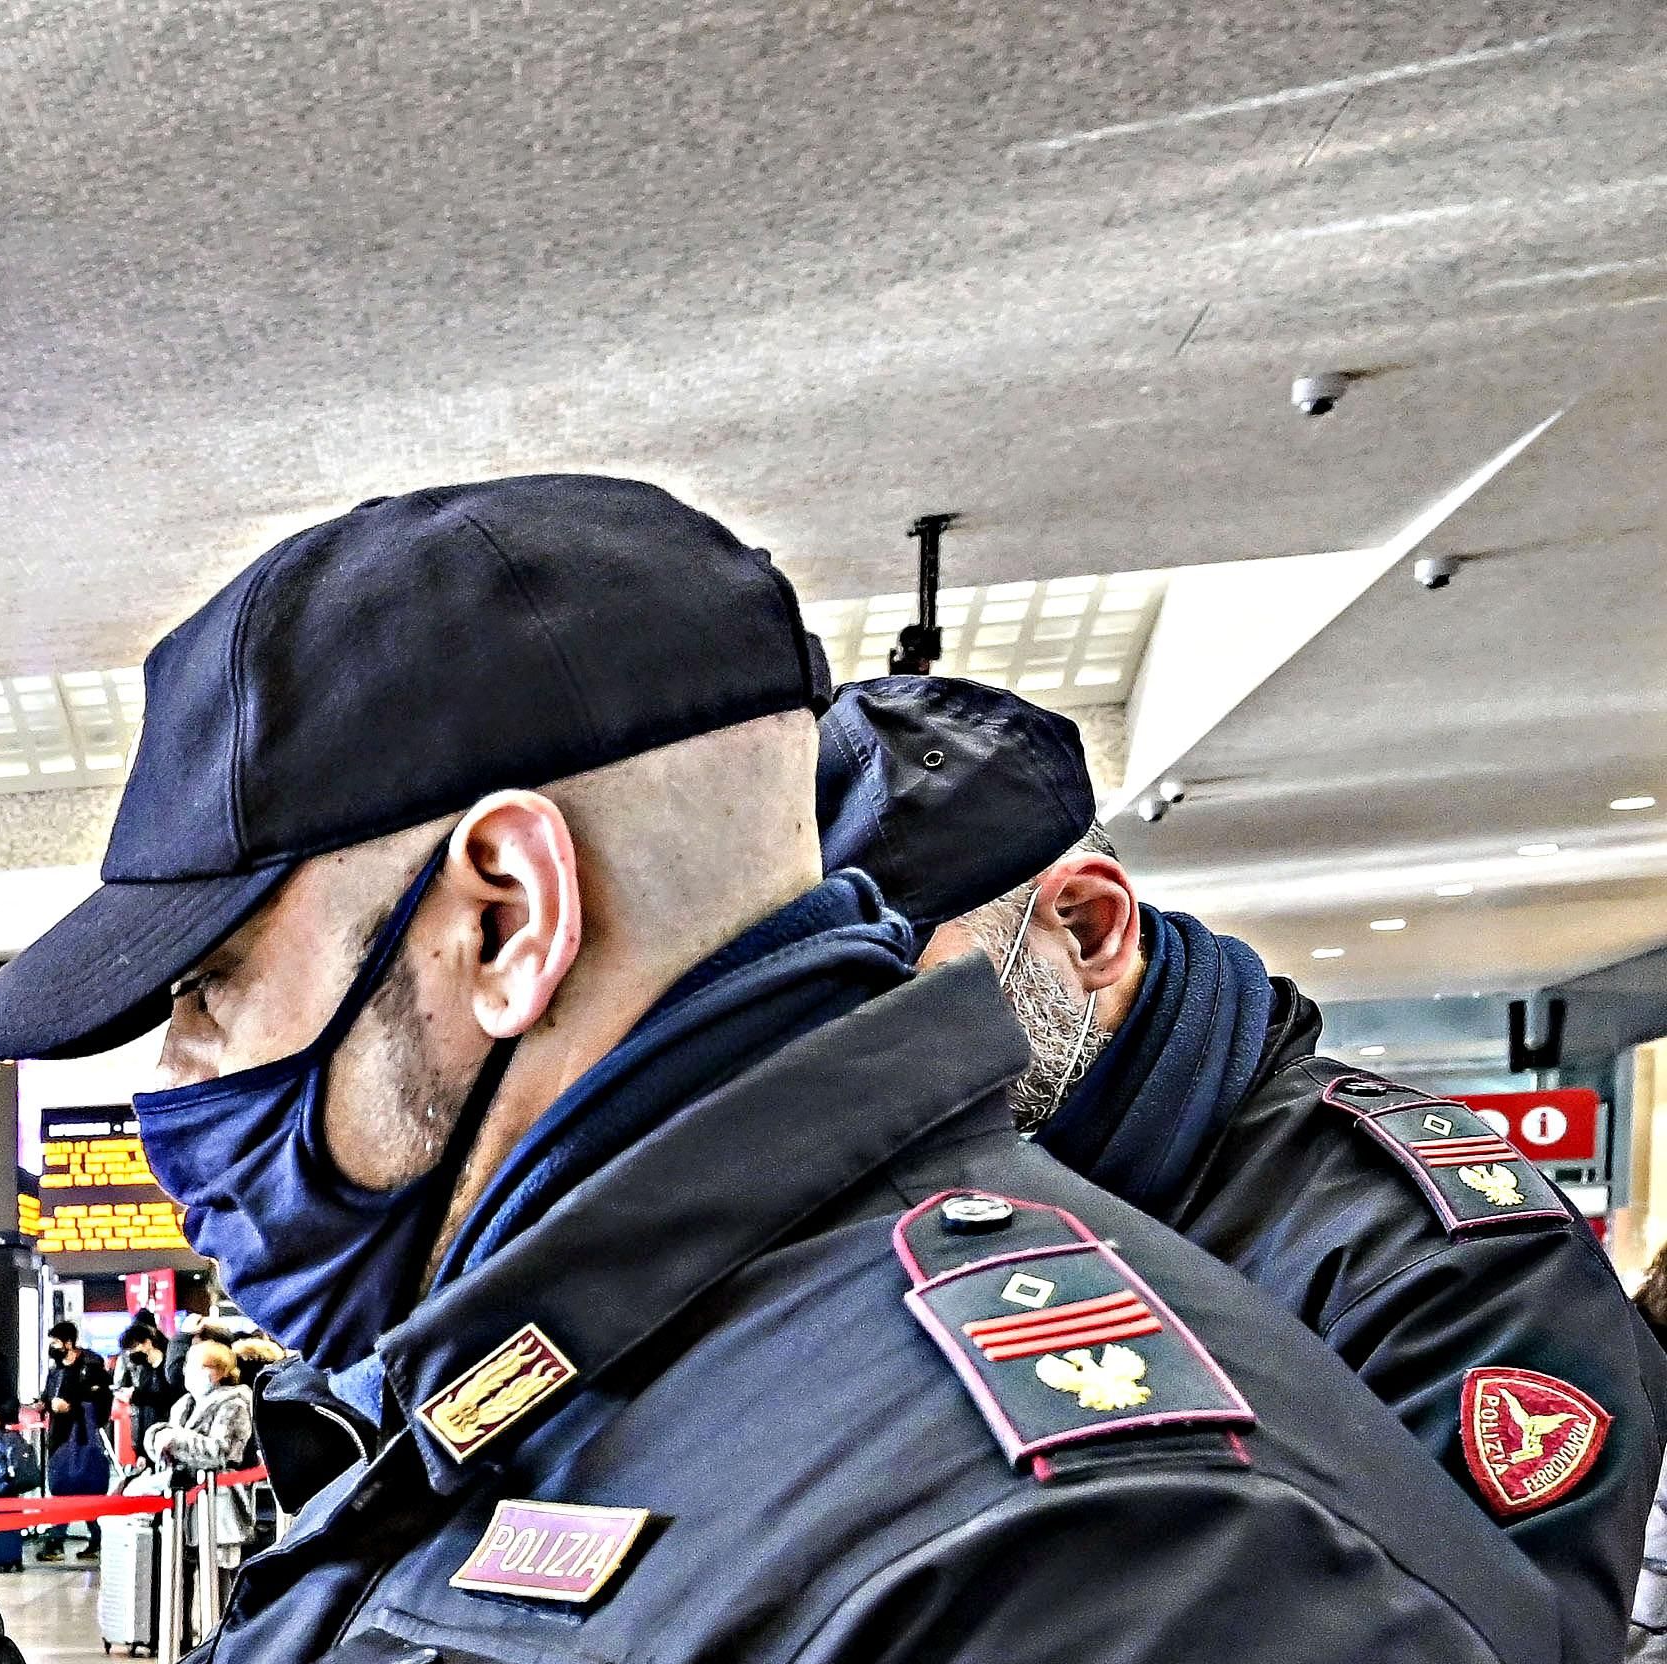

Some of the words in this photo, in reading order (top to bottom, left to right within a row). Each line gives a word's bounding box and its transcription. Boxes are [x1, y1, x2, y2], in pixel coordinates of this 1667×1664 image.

[1480, 1394, 1510, 1476] POLIZIA
[1521, 1422, 1589, 1494] FERROVIARIA
[475, 1524, 617, 1578] POLIZIA
